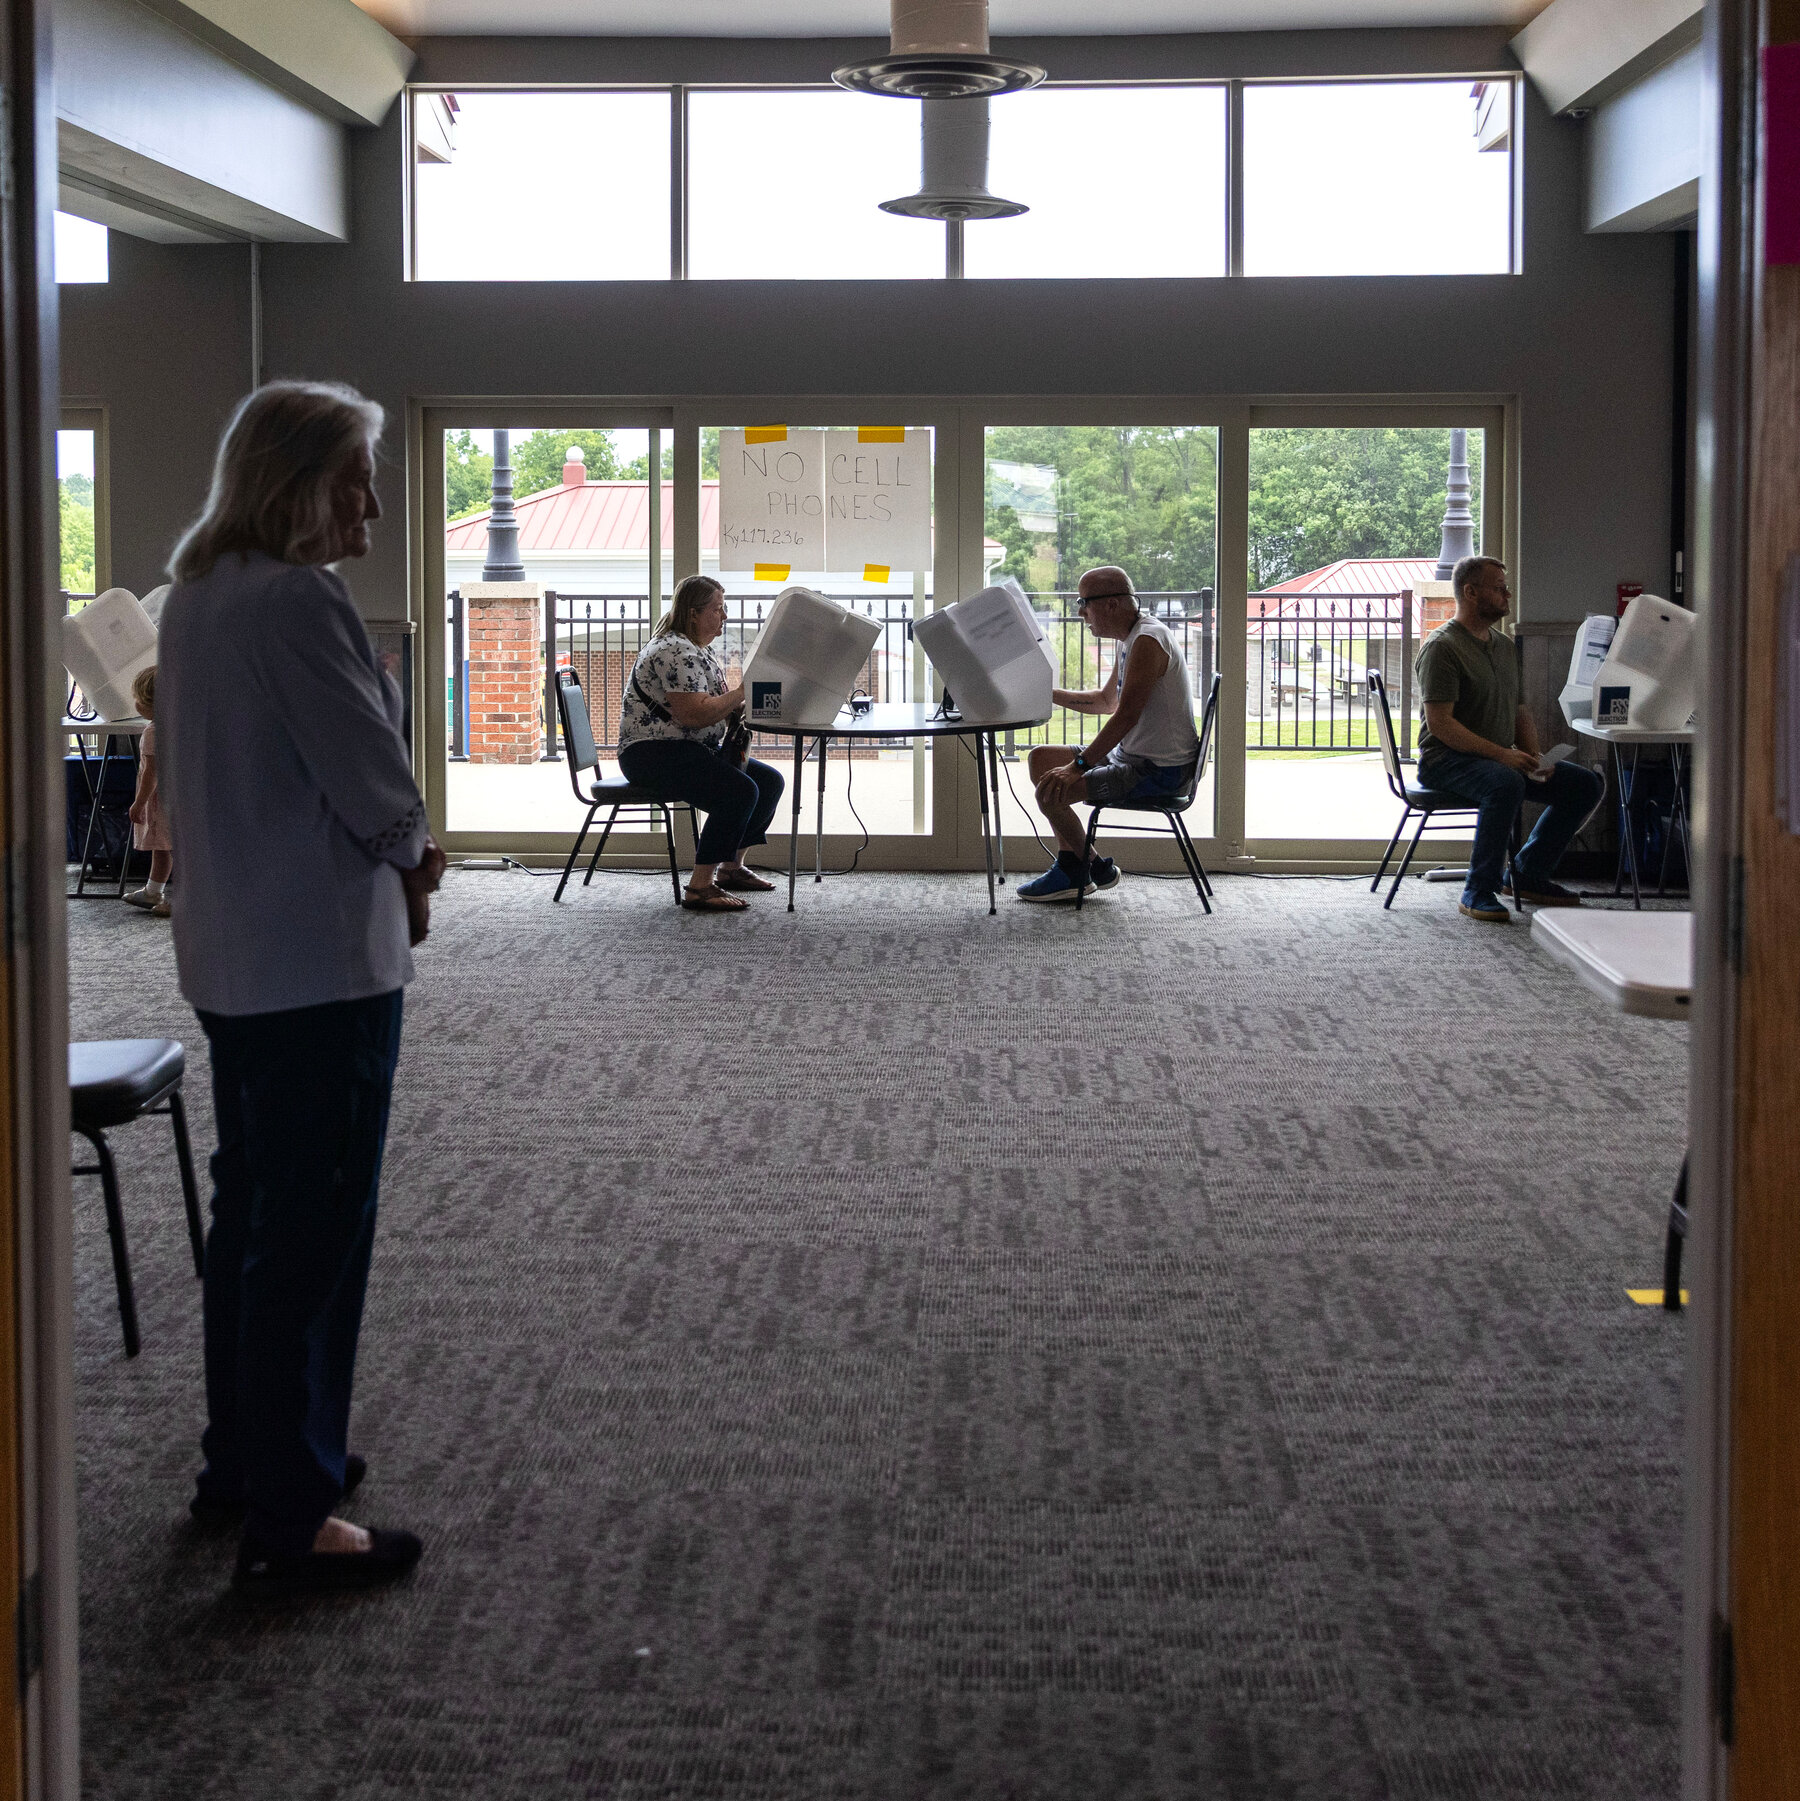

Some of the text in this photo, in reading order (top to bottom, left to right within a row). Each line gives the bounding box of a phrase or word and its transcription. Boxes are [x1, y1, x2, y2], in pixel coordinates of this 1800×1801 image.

[742, 448, 911, 487] NO CELL
[767, 491, 892, 522] PHONES
